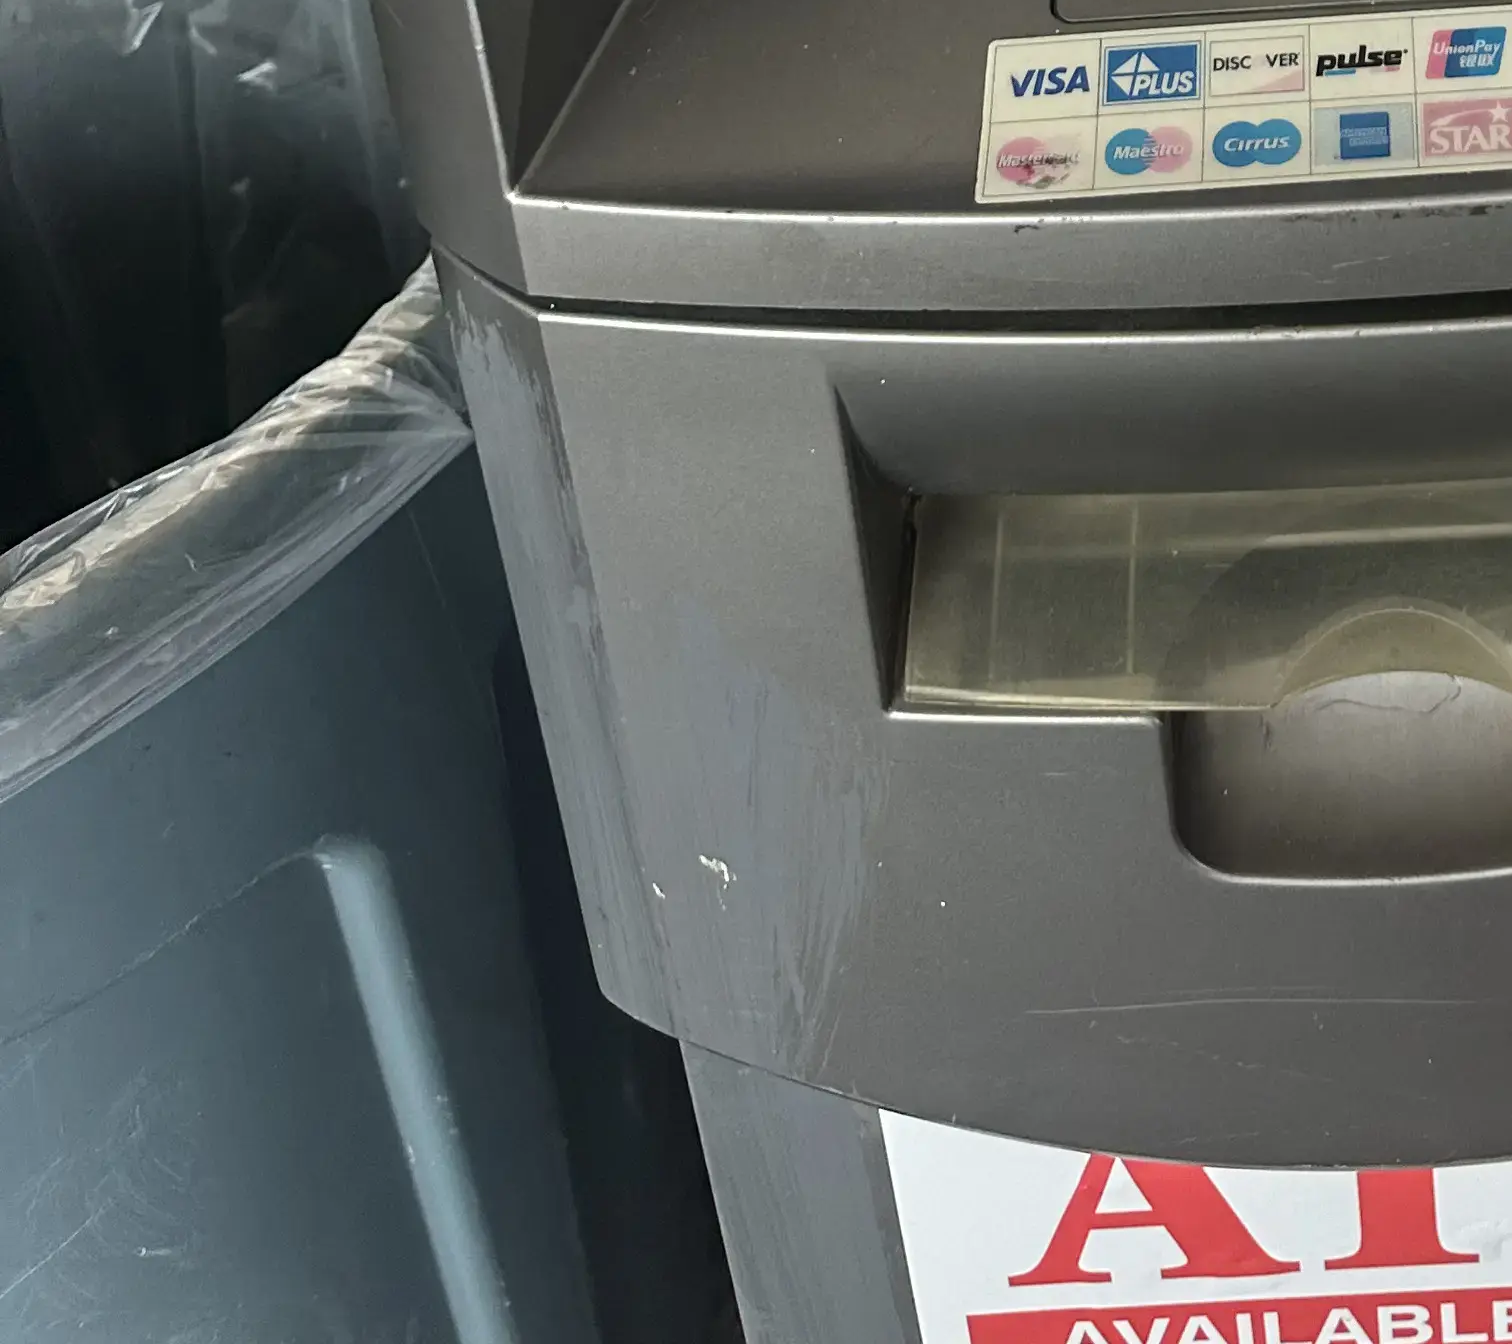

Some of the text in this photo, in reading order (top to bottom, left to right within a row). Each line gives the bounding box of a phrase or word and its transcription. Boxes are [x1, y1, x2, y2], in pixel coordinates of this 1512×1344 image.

[1432, 39, 1501, 58] UnionPay
[1213, 52, 1300, 72] DISCVER
[1315, 44, 1403, 77] pulse
[1011, 65, 1090, 97] VISA
[1131, 70, 1194, 97] PLUS
[1113, 142, 1185, 160] Maestro
[1223, 135, 1290, 153] Cirrus
